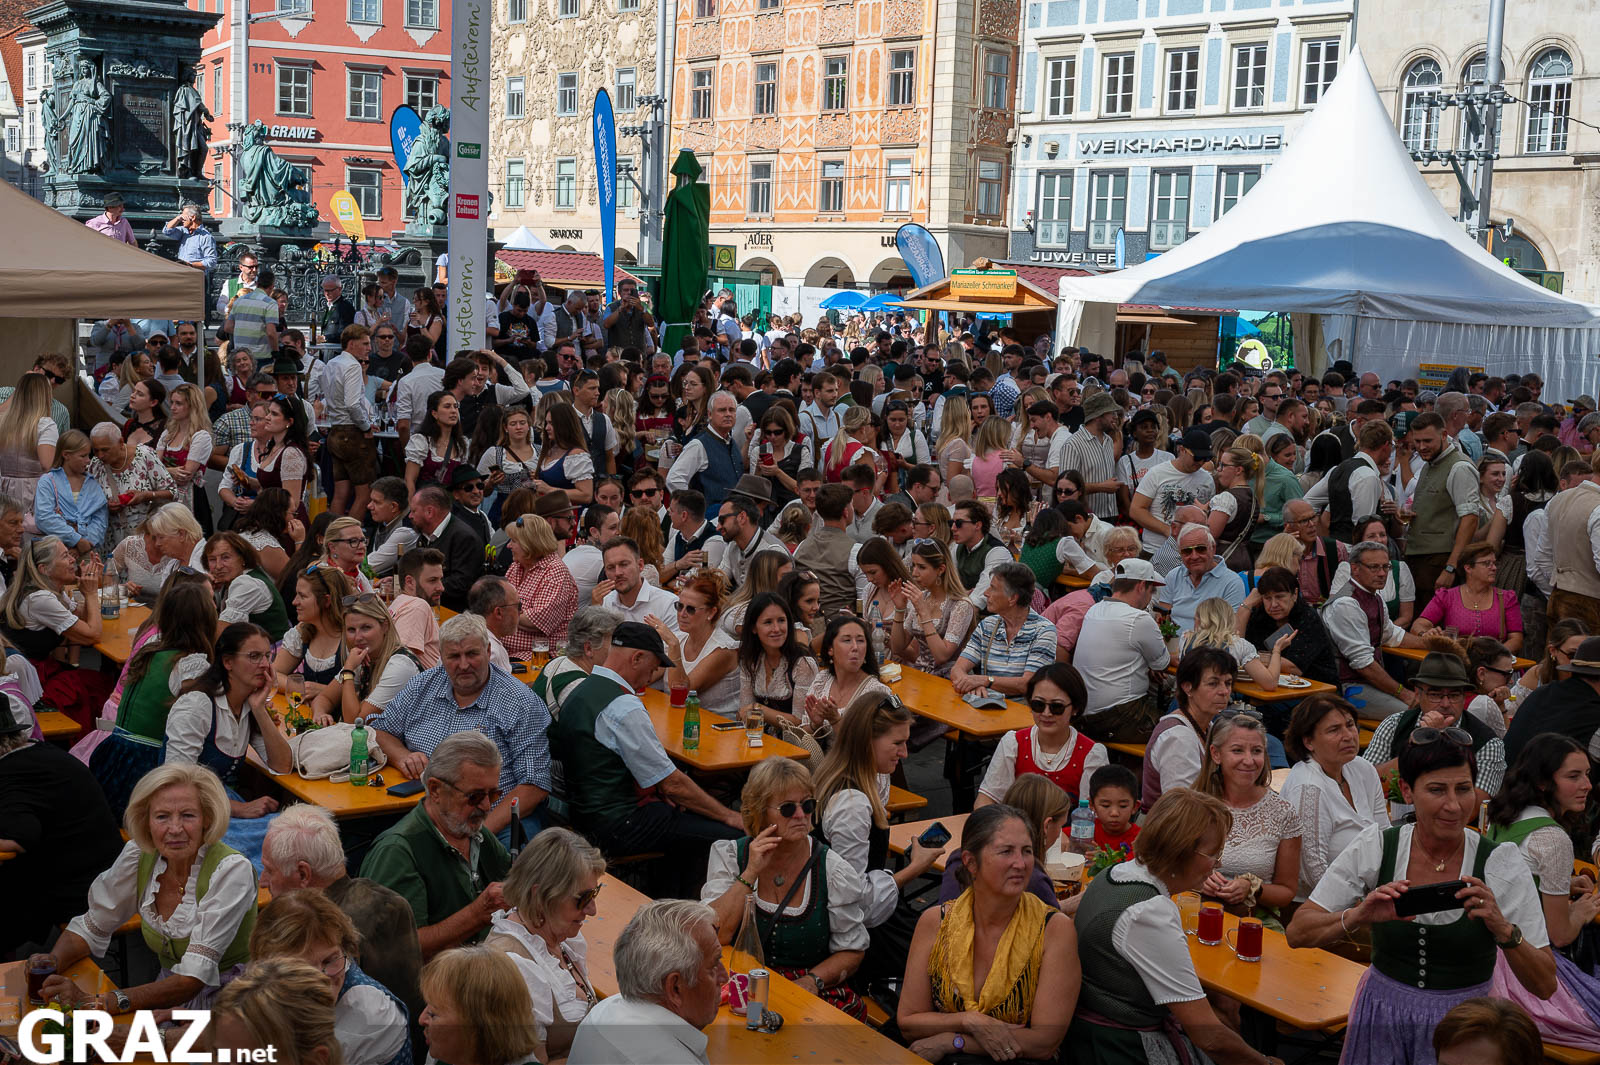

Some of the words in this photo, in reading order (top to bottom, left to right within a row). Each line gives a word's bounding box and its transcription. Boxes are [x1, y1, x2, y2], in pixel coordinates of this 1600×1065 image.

[460, 4, 482, 112] Aufsteirern
[270, 125, 317, 139] GRAWE
[1078, 136, 1208, 154] WEIKHARD
[1211, 134, 1281, 151] HAUS
[457, 196, 478, 206] Kronen
[456, 206, 478, 216] Zeitung
[549, 229, 583, 239] SWAROVSKI
[456, 257, 477, 352] ufsteirern
